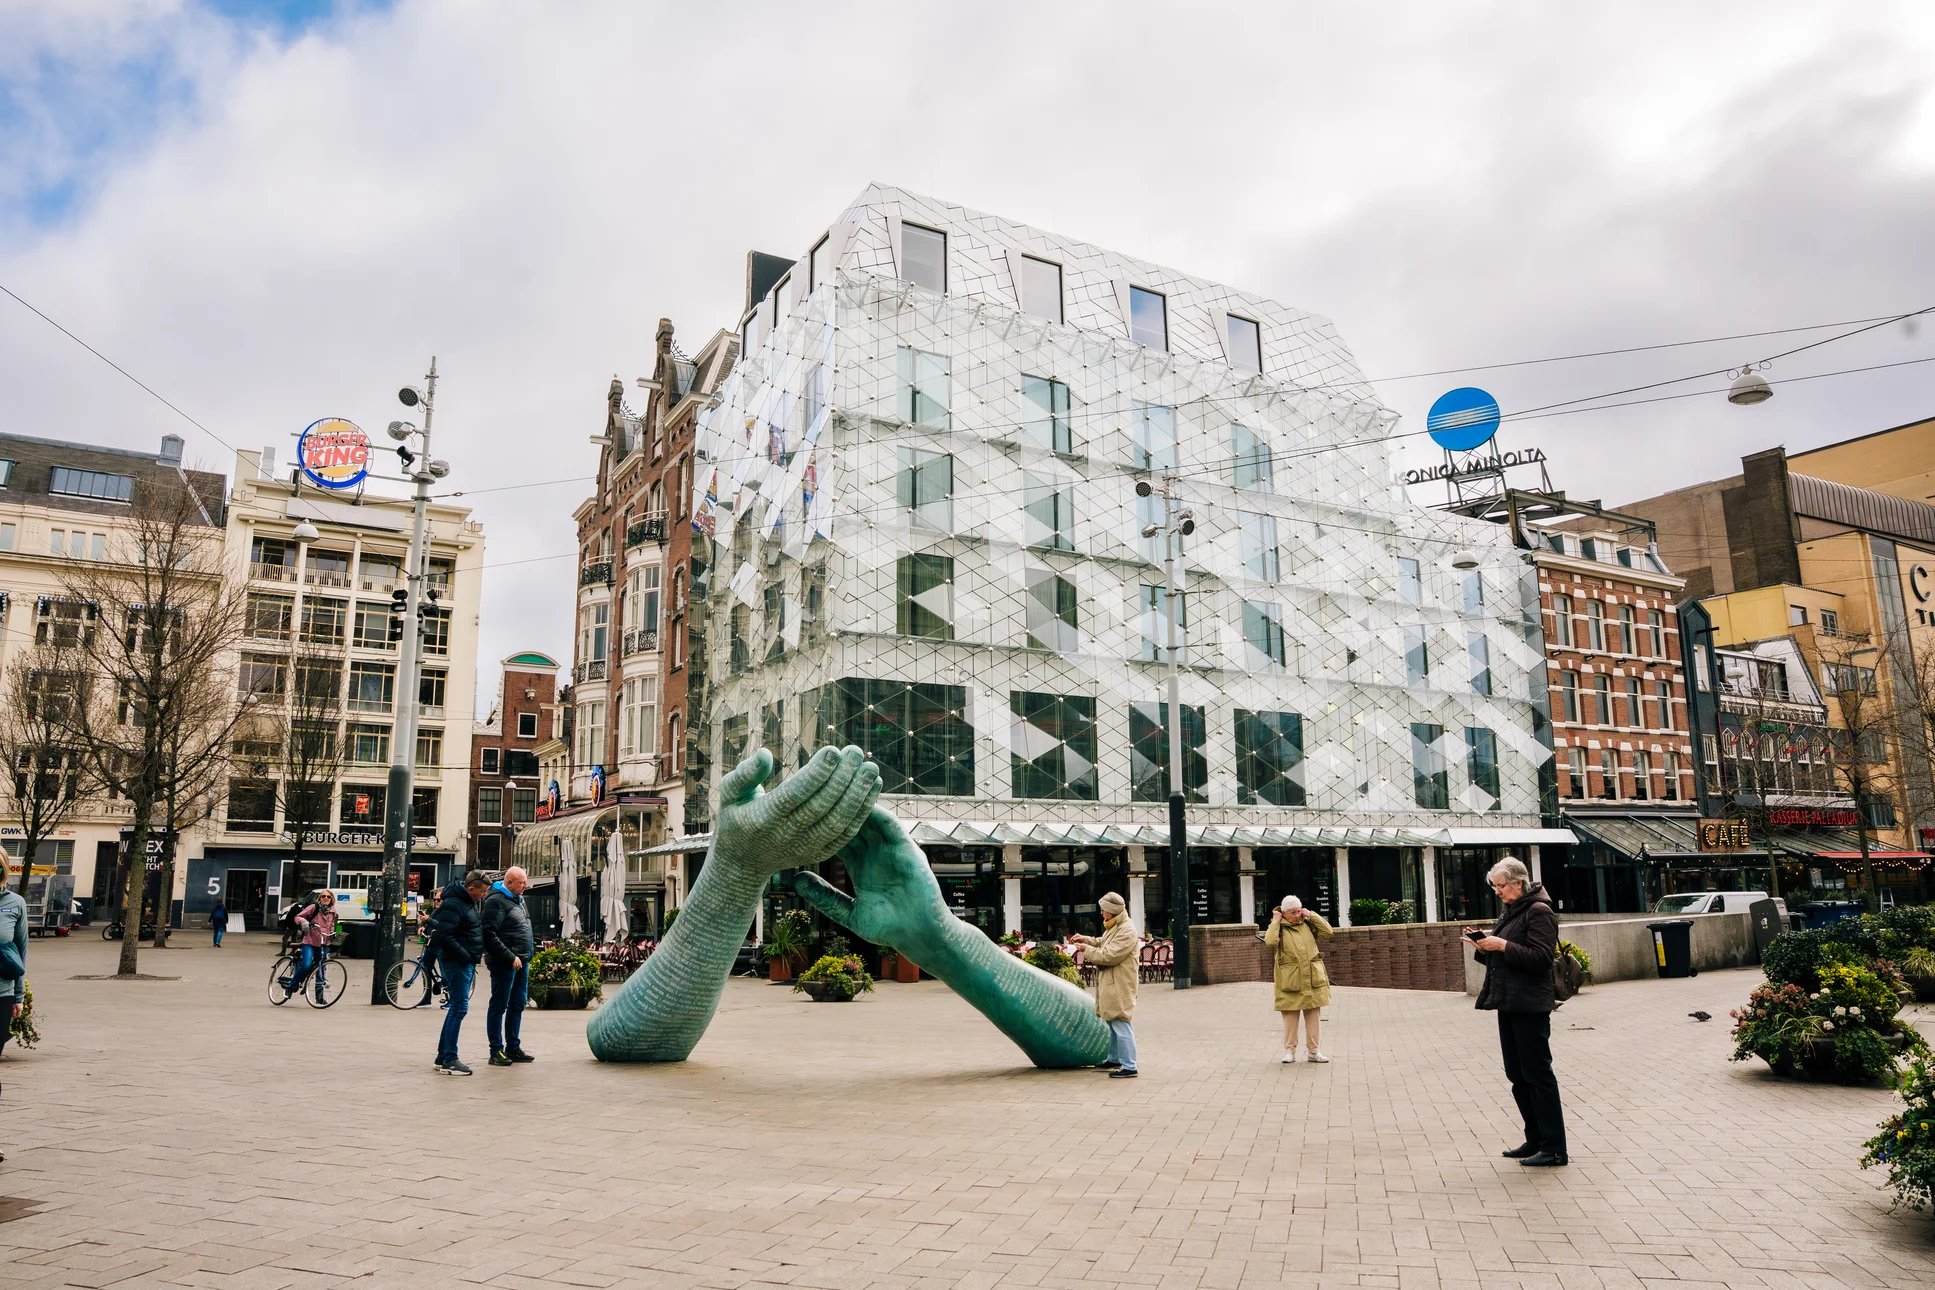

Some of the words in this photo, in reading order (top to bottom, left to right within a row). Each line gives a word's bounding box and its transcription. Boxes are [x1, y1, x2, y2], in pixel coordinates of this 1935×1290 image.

[306, 433, 367, 450] BURGER
[305, 446, 369, 469] KING
[1466, 447, 1548, 474] MINOLTA
[1766, 810, 1811, 824] RASSERIE
[303, 831, 371, 845] BURGER
[1705, 818, 1750, 846] CAFÉ
[207, 877, 221, 896] 5
